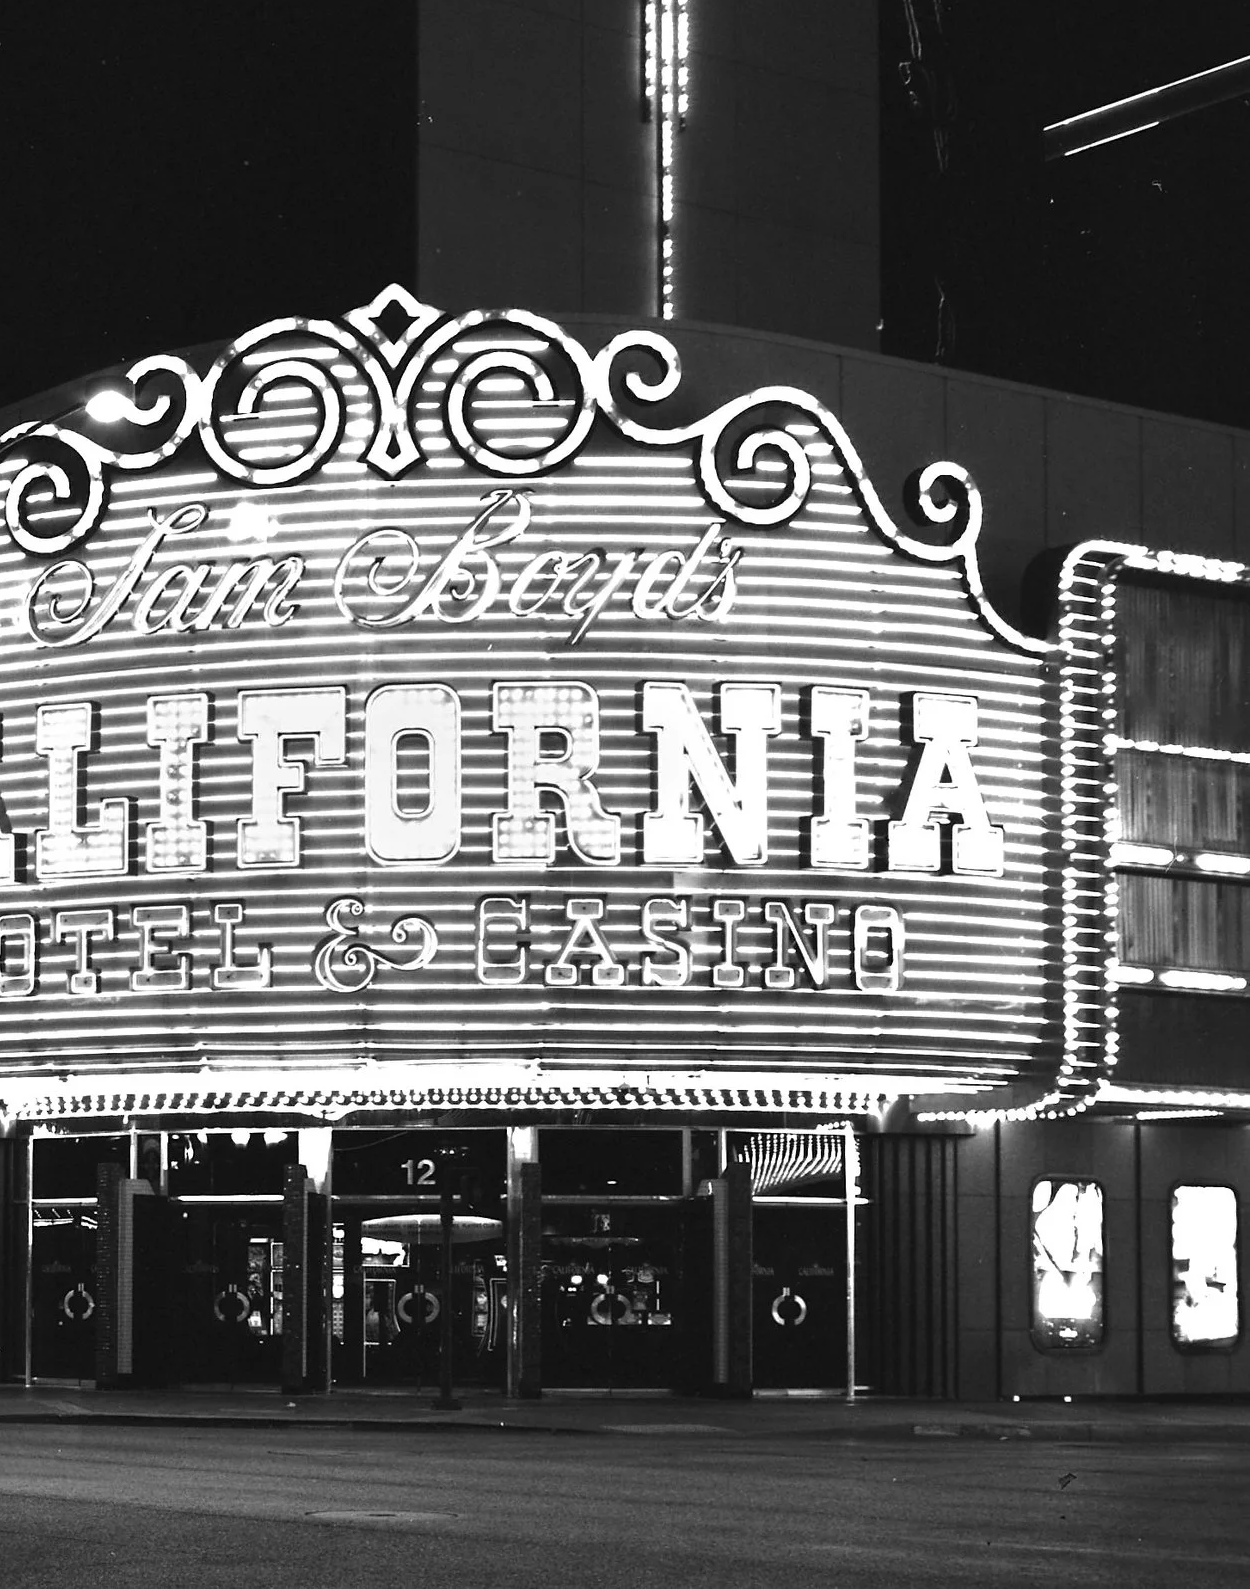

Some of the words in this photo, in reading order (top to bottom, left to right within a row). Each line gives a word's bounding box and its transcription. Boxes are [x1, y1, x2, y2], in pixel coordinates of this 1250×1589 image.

[24, 503, 306, 648] Sam
[334, 489, 743, 645] Boyd's
[314, 897, 438, 993] &
[476, 896, 906, 992] CASINO
[401, 1159, 436, 1185] 12
